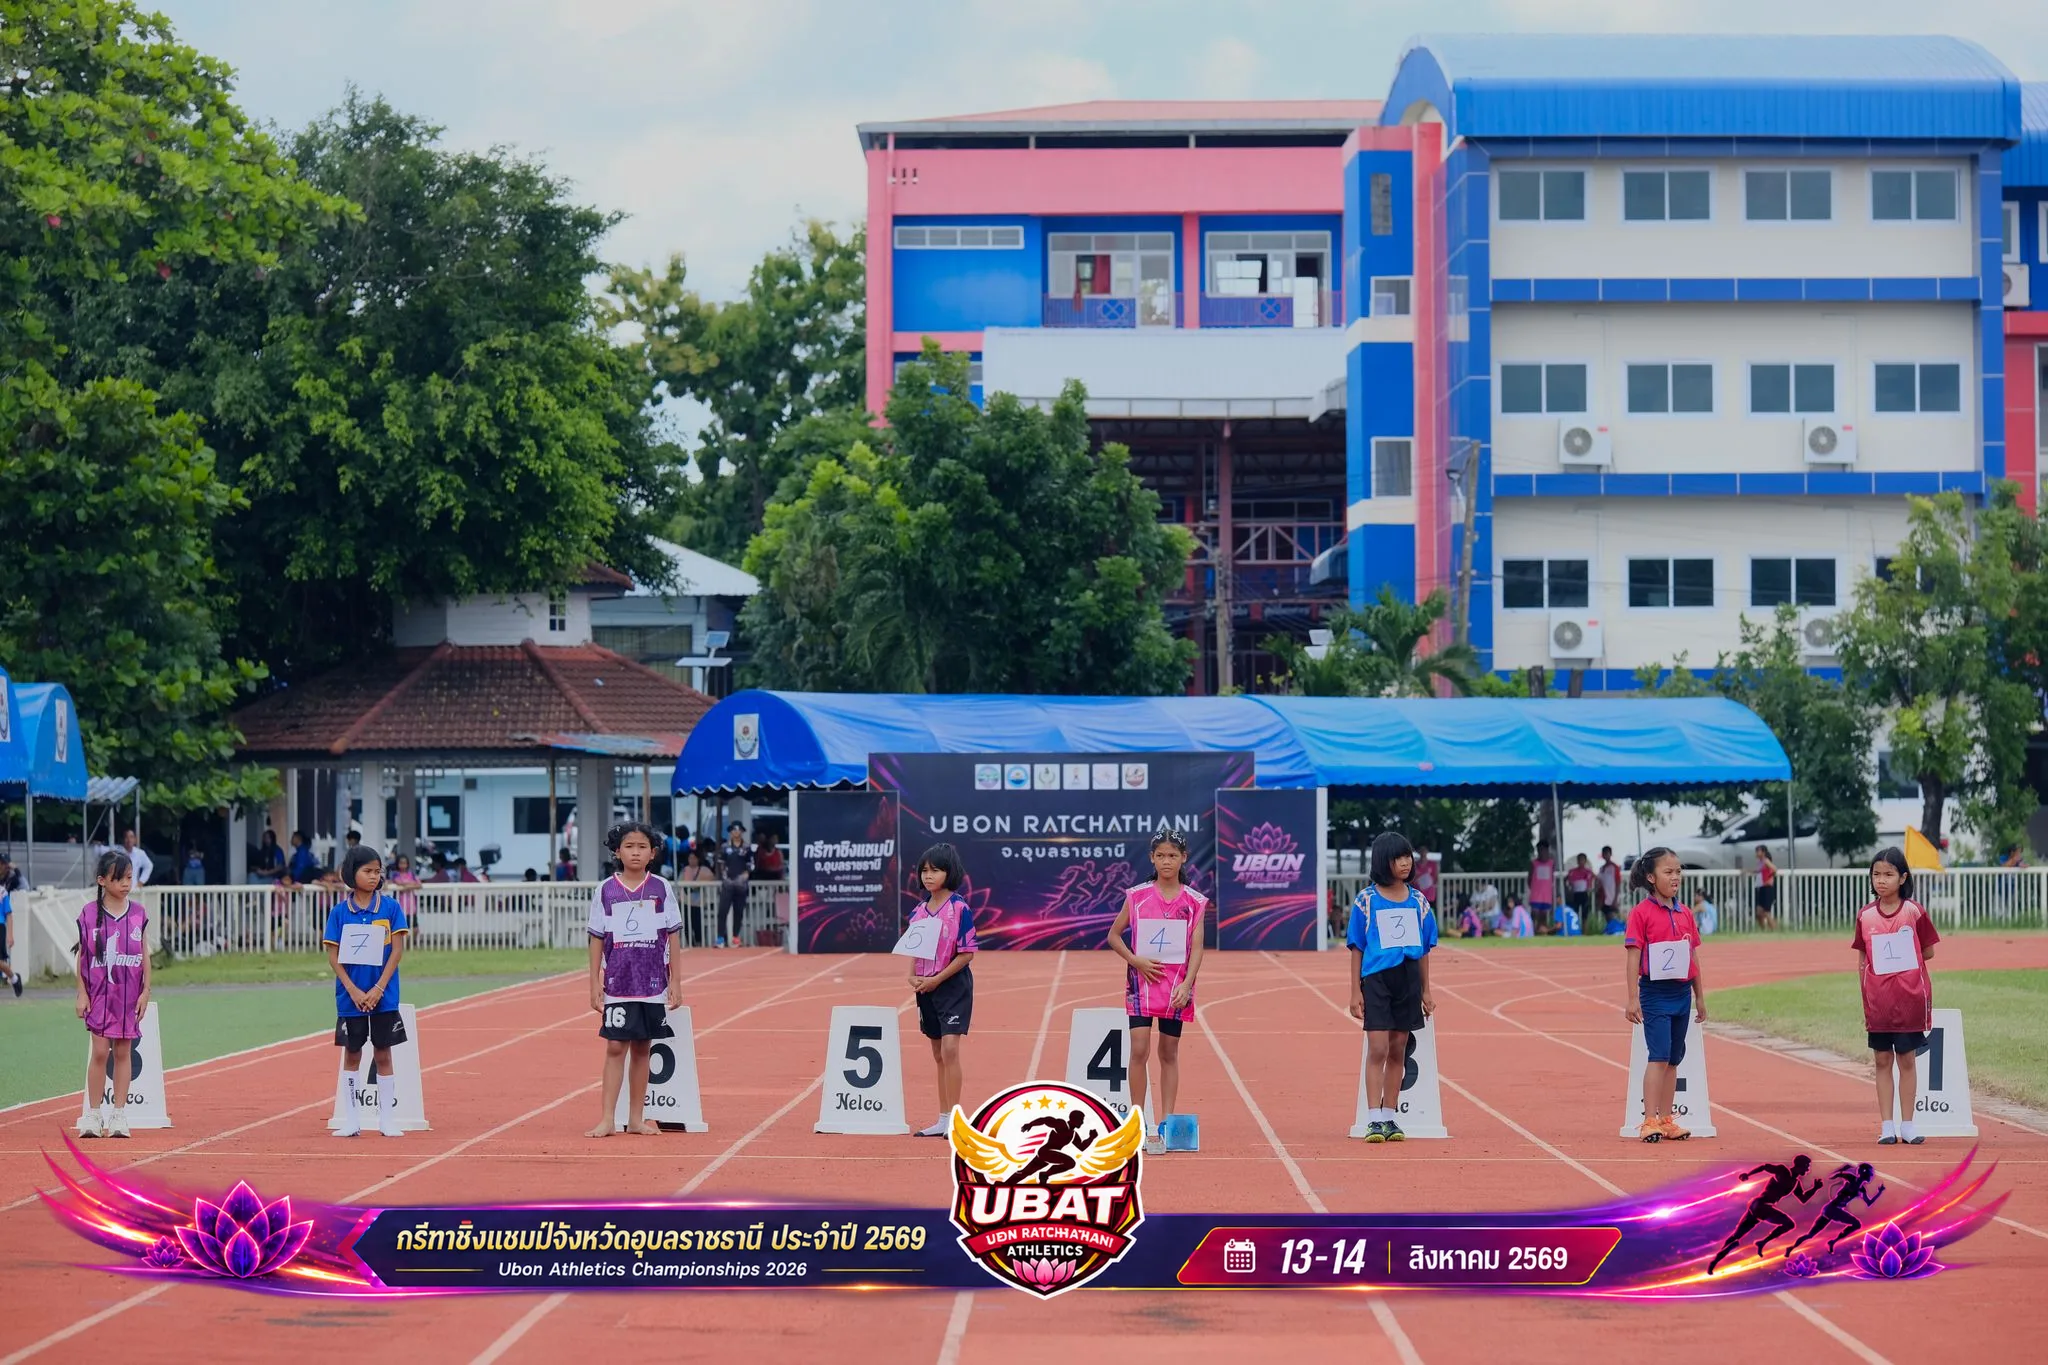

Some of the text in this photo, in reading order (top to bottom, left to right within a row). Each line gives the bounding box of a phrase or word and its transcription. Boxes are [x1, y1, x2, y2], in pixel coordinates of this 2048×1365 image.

[929, 814, 1199, 834] UBON RATCHATHANI
[1001, 843, 1126, 863] จ.อุบลราชธานี
[1232, 853, 1306, 872] UBON
[1233, 871, 1302, 882] ATHLETICS
[625, 906, 639, 932] 6
[1390, 915, 1406, 940] 3
[350, 933, 370, 956] 7
[904, 925, 925, 950] 5
[1149, 927, 1171, 953] 4
[1662, 948, 1676, 971] 2
[1883, 941, 1902, 960] 1
[604, 1006, 627, 1029] 16
[843, 1025, 883, 1089] 5
[1087, 1029, 1127, 1092] 4
[643, 1090, 676, 1107] elco
[835, 1092, 883, 1112] Nelco
[1915, 1095, 1950, 1113] elco
